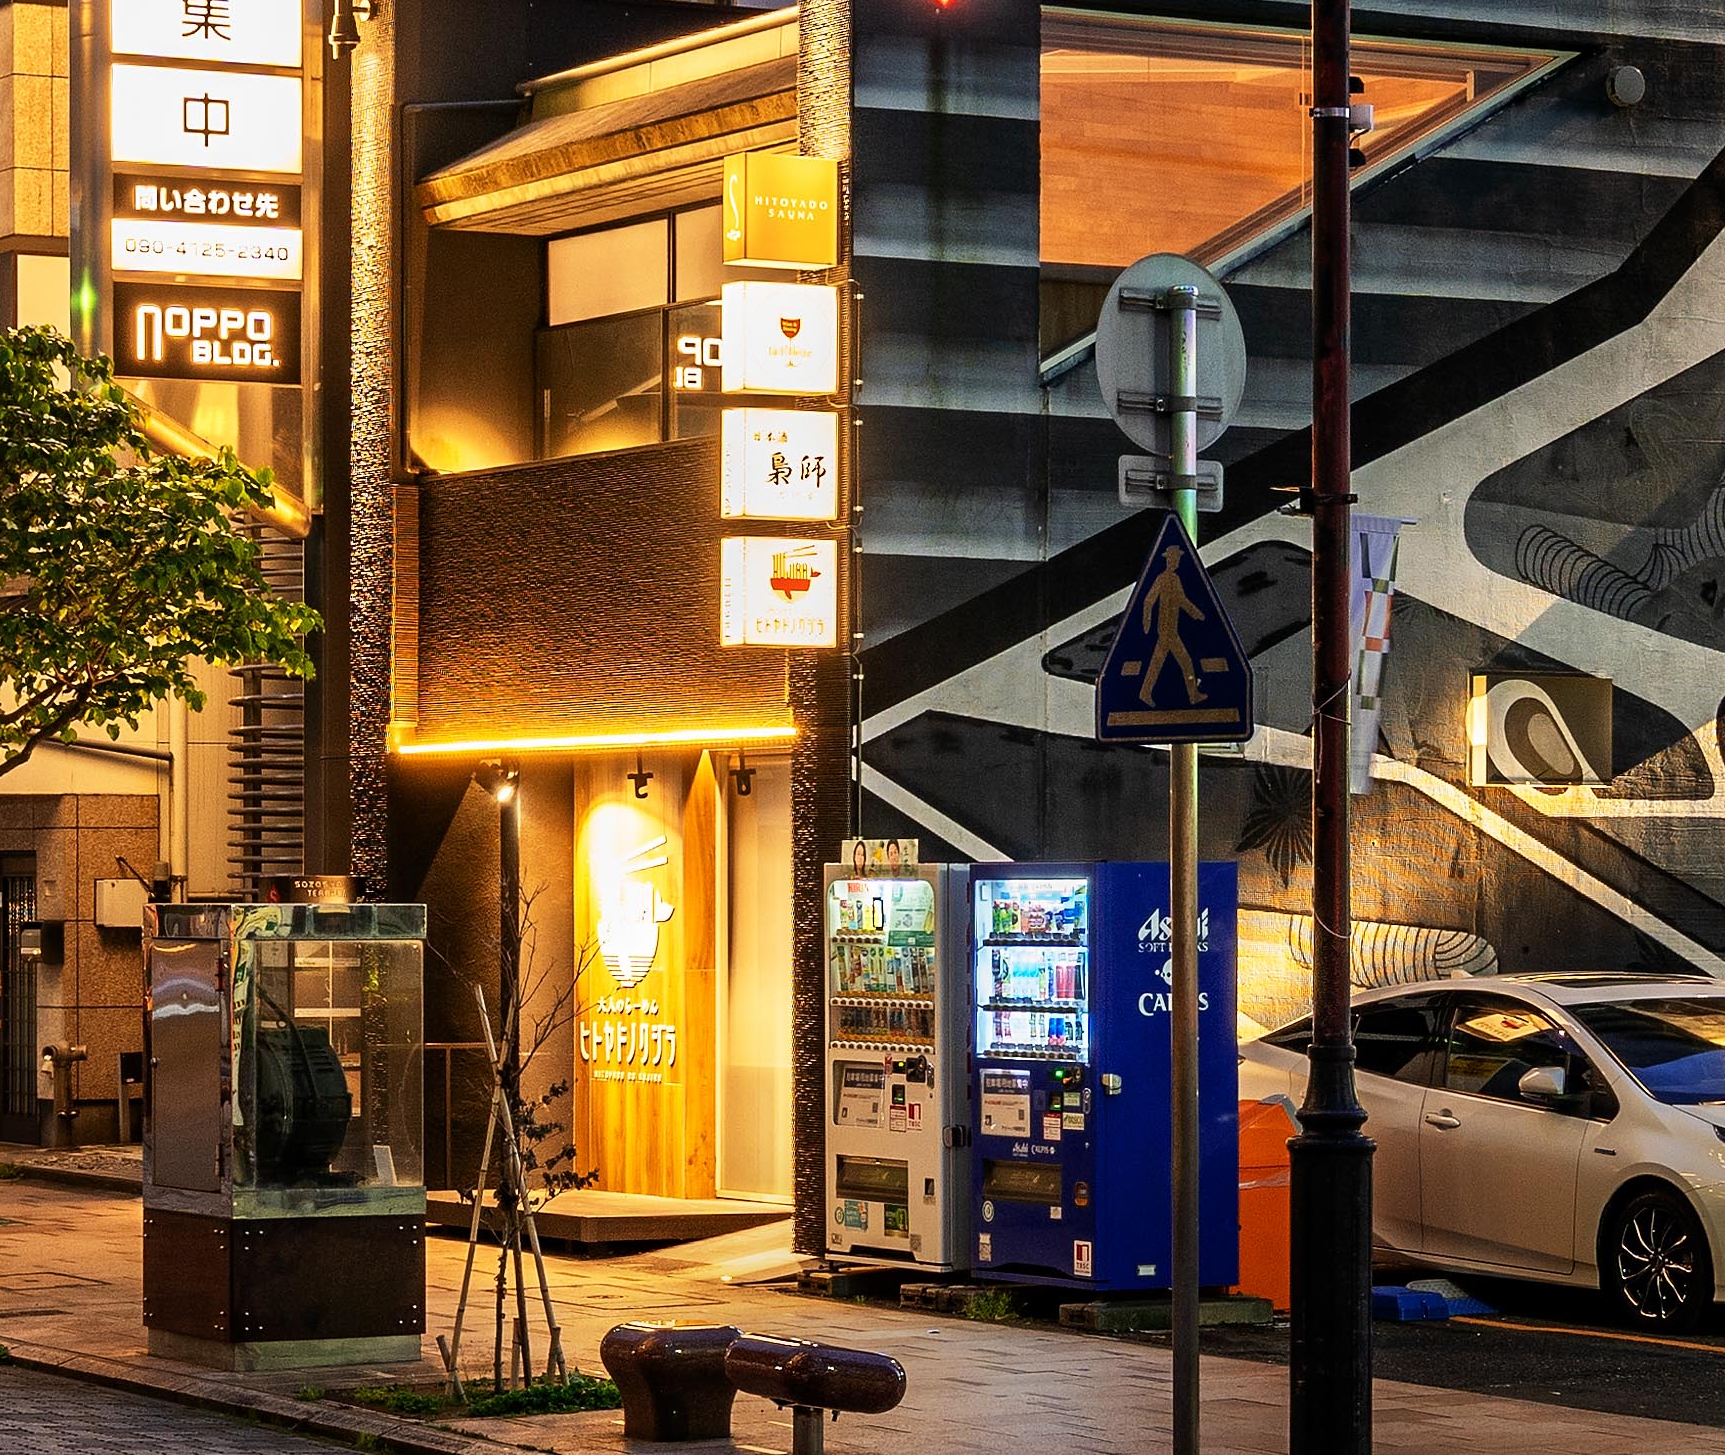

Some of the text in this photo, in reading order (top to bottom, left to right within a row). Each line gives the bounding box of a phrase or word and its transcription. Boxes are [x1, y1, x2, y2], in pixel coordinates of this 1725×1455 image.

[134, 184, 279, 219] 問い合わせ先
[754, 195, 829, 211] HITOYADO
[768, 208, 815, 221] SAUNA
[125, 238, 289, 261] 090-4125-2340
[136, 304, 272, 361] NOPPO
[191, 339, 281, 367] BLDG.
[1137, 907, 1209, 941] Asi
[1137, 942, 1167, 953] SOFT
[579, 1020, 677, 1067] ヒトヤドノクジラ
